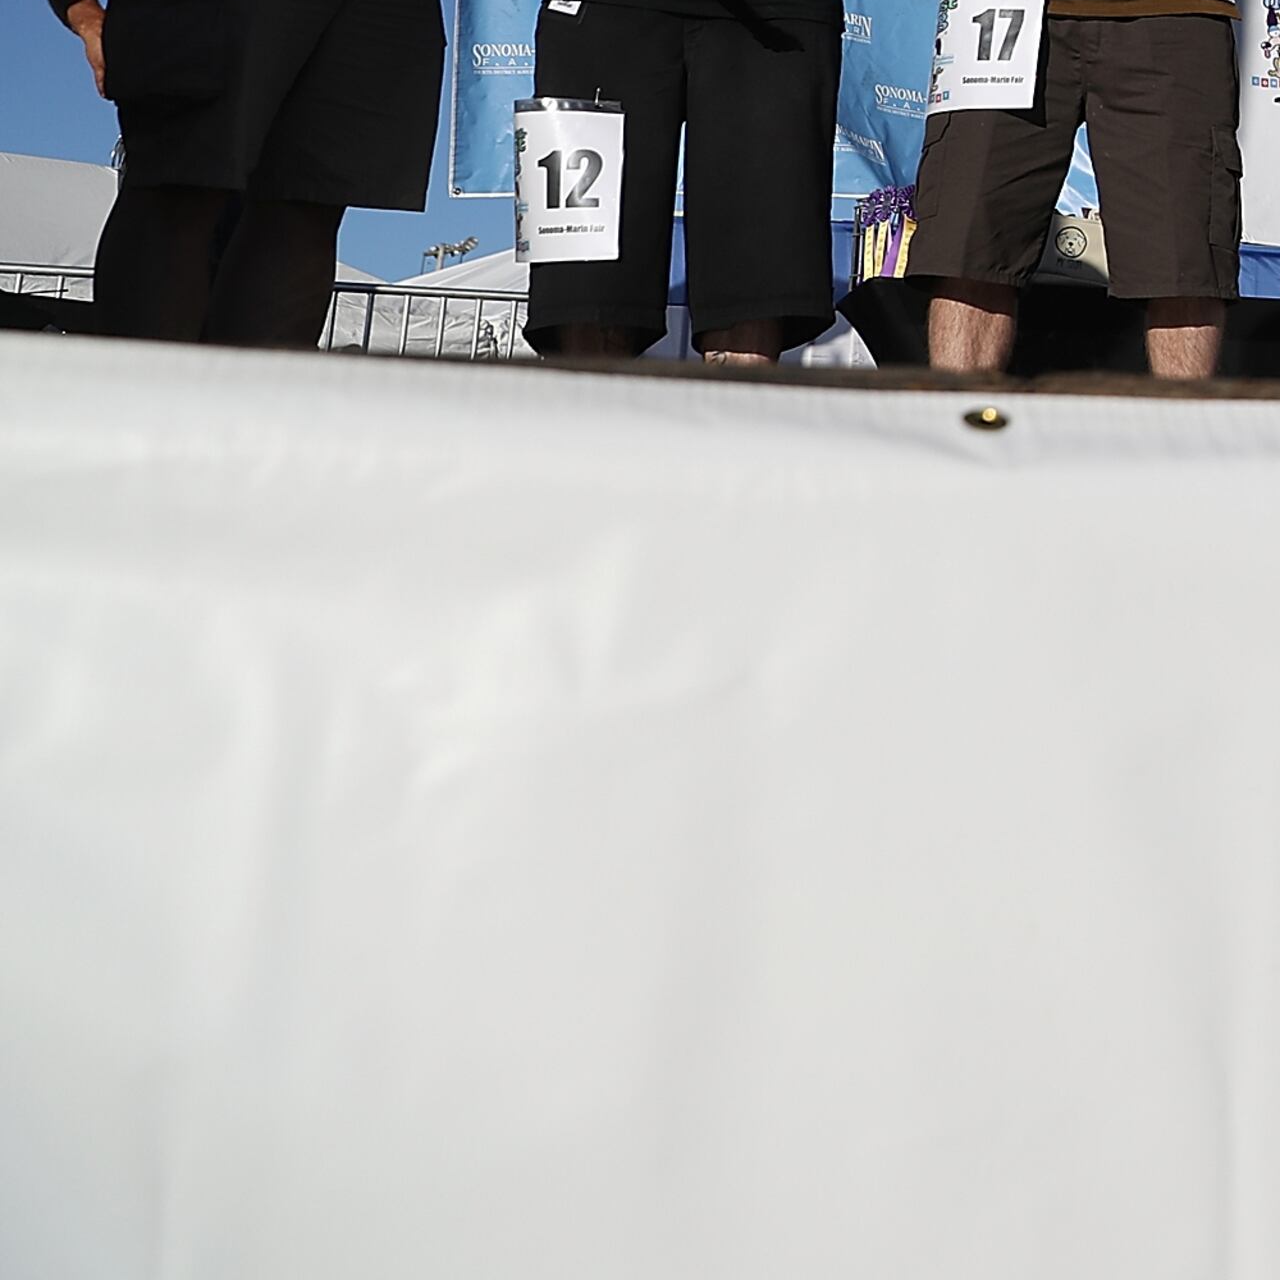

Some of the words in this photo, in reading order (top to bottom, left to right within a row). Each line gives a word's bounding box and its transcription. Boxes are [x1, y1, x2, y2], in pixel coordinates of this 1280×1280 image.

[972, 8, 1025, 61] 17
[473, 43, 535, 67] SONOMA-
[962, 76, 1010, 85] Sonoma-Marin
[1011, 76, 1024, 84] Fair
[875, 84, 927, 104] SONOMA-
[537, 149, 603, 209] 12
[538, 225, 588, 234] Sonoma-Marin
